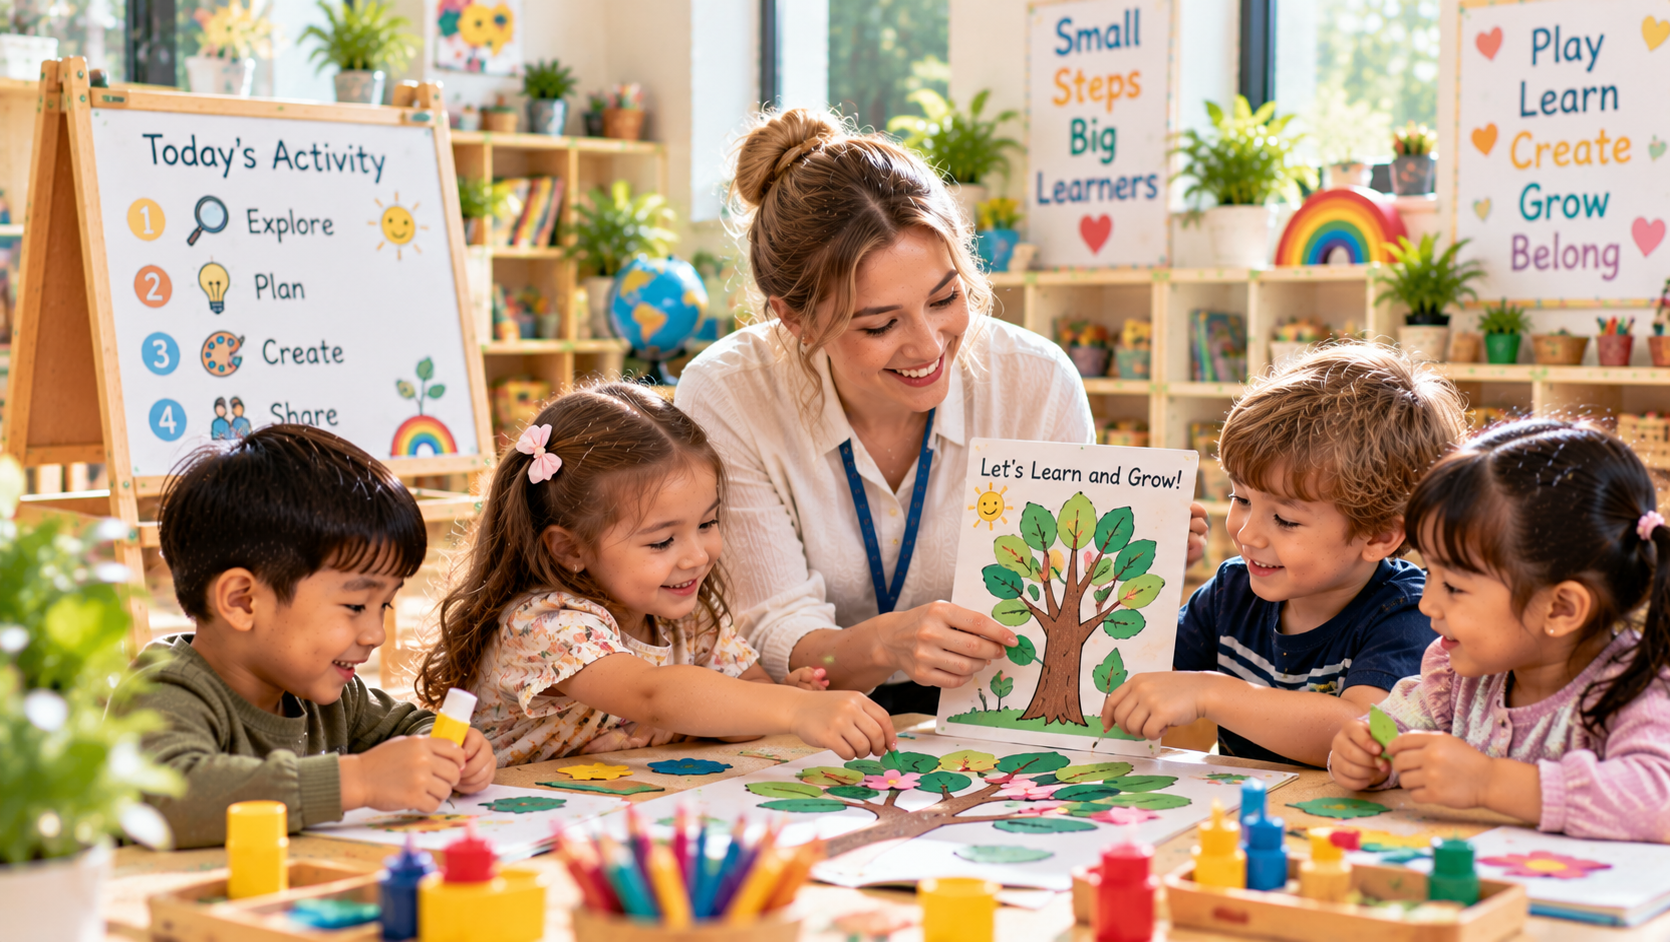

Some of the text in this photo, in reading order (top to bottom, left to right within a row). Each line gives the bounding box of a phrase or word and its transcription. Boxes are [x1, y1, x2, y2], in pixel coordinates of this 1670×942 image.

[1055, 8, 1140, 56] Small
[1532, 25, 1604, 73] Play
[1053, 68, 1140, 112] Steps
[1520, 81, 1618, 118] Learn
[142, 134, 385, 184] Today's Activity
[1070, 118, 1116, 165] Big
[1510, 129, 1631, 170] Create
[1037, 172, 1157, 205] Learners
[1519, 182, 1610, 221] Grow
[139, 204, 334, 243] 1 Explore
[1512, 233, 1619, 281] Belong
[143, 271, 304, 302] 2 Plan
[151, 339, 344, 369] 3 Create
[158, 401, 339, 435] 4 Share
[981, 458, 1182, 489] Let's Learn and Grow!
